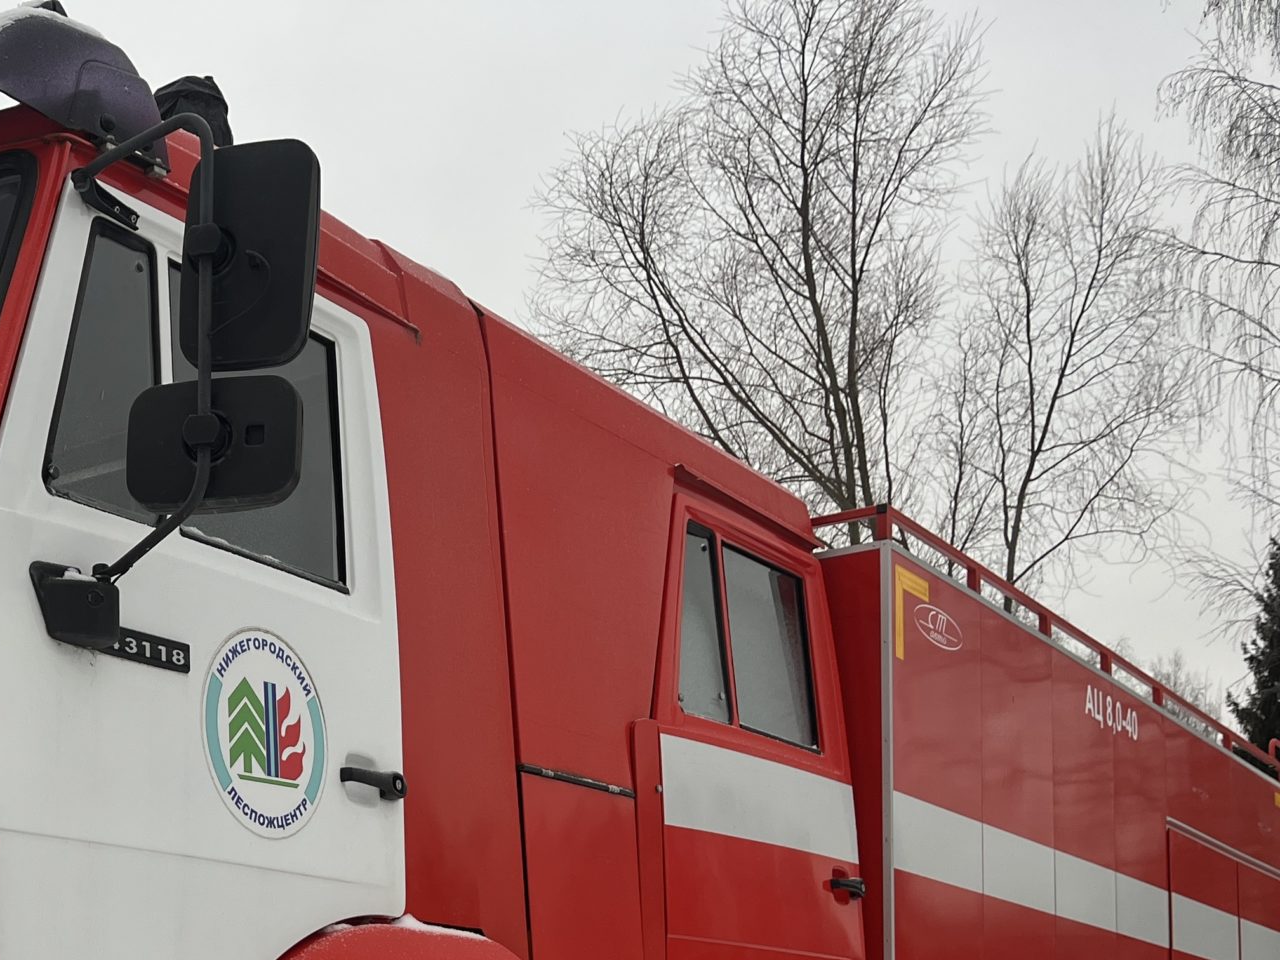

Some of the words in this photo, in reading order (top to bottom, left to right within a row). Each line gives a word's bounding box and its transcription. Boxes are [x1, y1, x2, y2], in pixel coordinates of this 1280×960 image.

[216, 637, 312, 697] НИЖЕГОРОДСКИЙ
[1085, 685, 1104, 729] АЦ
[1106, 695, 1138, 741] 8,0-40
[227, 786, 308, 830] ЛЕСПОЖЦЕНТР
